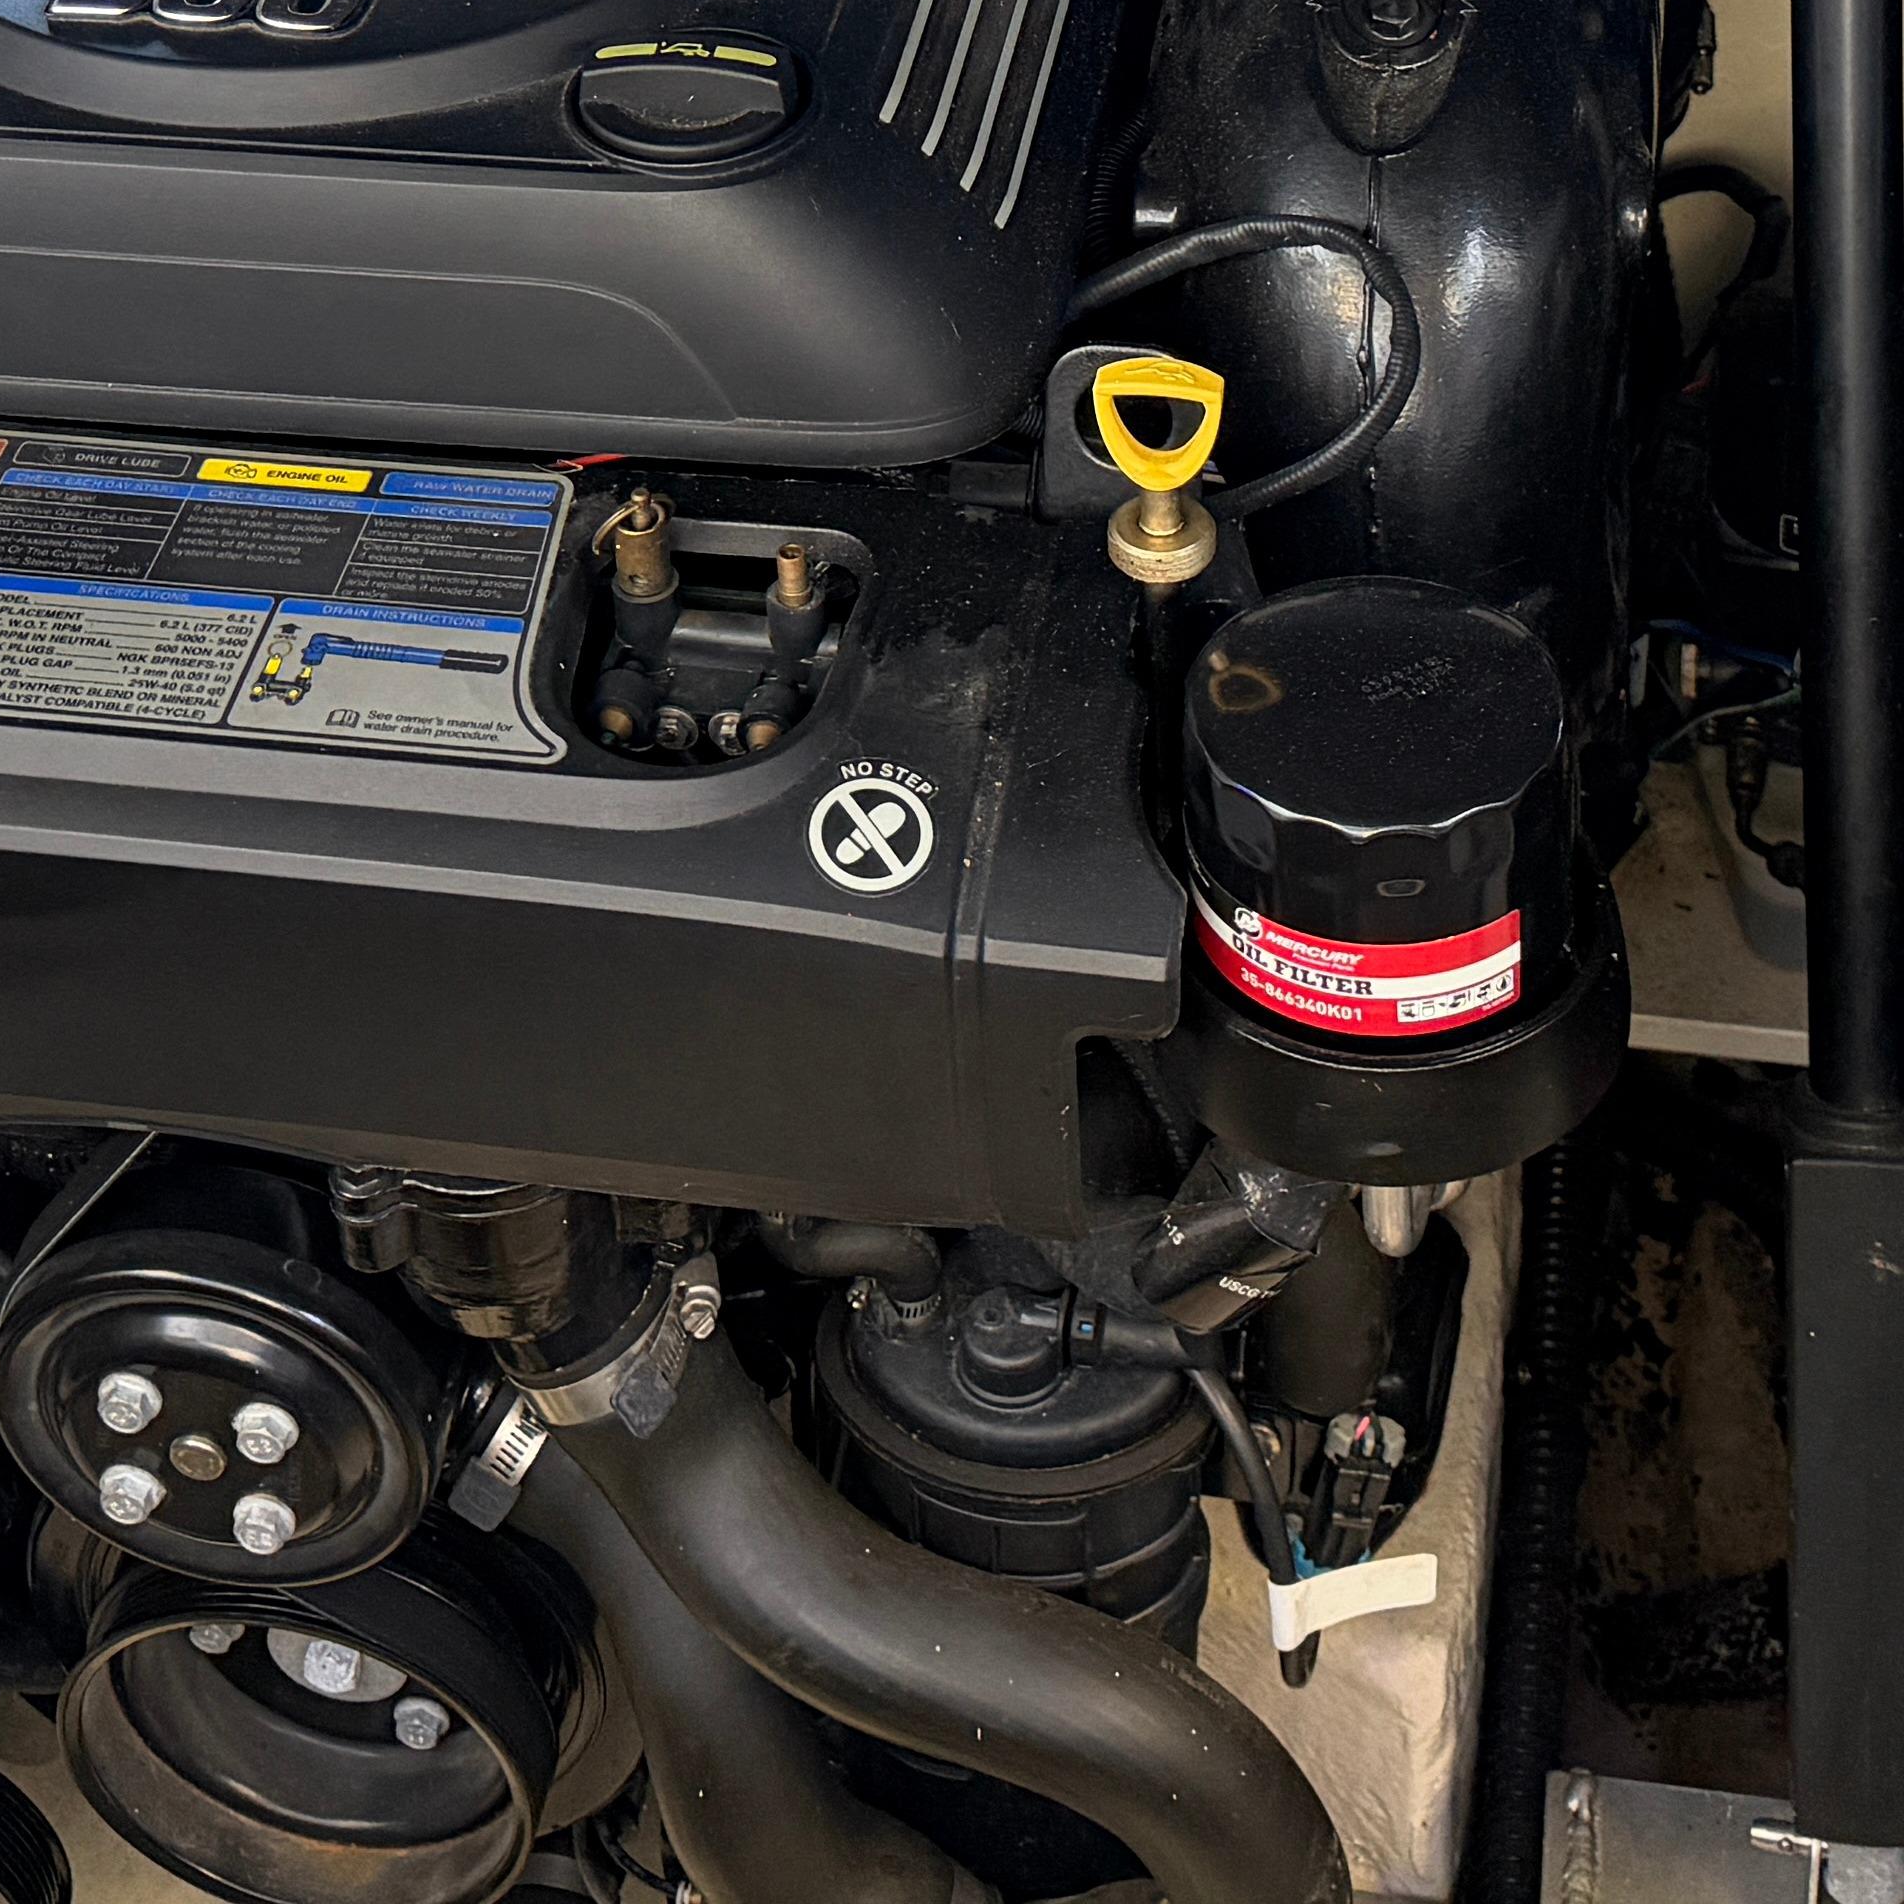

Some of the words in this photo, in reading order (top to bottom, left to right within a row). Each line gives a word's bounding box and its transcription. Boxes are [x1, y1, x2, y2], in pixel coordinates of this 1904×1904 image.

[73, 453, 119, 464] DRIVE
[120, 457, 162, 468] LUBE
[13, 473, 63, 484] CHECK
[265, 470, 322, 481] ENGINE
[324, 474, 349, 483] OIL
[504, 487, 552, 499] DRAIN
[409, 504, 459, 516] CHECK
[77, 584, 191, 601] SPECIFICATIONS
[225, 613, 248, 622] 6.2
[321, 604, 370, 617] DRAIN
[371, 609, 487, 627] INSTRUCTIONS
[6, 618, 50, 629] W.O.T.
[50, 622, 83, 632] RPM
[173, 633, 206, 643] 5000
[216, 637, 248, 647] 5400
[158, 620, 180, 629] 6.2
[192, 622, 223, 633] (377
[223, 625, 254, 636] CID)
[6, 643, 56, 654] PLUGS
[116, 652, 148, 663] NGK
[30, 633, 47, 641] IN
[48, 634, 114, 647] NEUTRAL
[180, 646, 213, 656] NON
[214, 649, 243, 659] ADJ
[0, 654, 40, 666] PLUG
[41, 658, 74, 669] GAP
[142, 668, 168, 677] mm
[212, 673, 232, 684] in)
[0, 667, 25, 677] OIL
[205, 685, 226, 696] qt)
[7, 680, 85, 694] SYNTHETIC
[85, 687, 134, 699] BLEND
[135, 691, 158, 701] OR
[159, 694, 222, 707] MINERAL
[43, 696, 135, 712] COMPATIBLE
[135, 704, 207, 720] (4-CYCLE)
[362, 721, 398, 731] water
[399, 724, 433, 735] drain
[434, 727, 501, 742] procedure.
[367, 710, 393, 720] See
[395, 713, 445, 725] owner's
[446, 717, 494, 730] manual
[494, 722, 514, 731] for
[840, 761, 873, 780] NO
[879, 762, 933, 794] STEP
[1265, 930, 1364, 966] MERCURY
[1232, 934, 1268, 968] OIL
[1274, 959, 1374, 996] FILTER
[1240, 967, 1363, 1021] 35-866340K01
[1219, 1276, 1261, 1298] USCG
